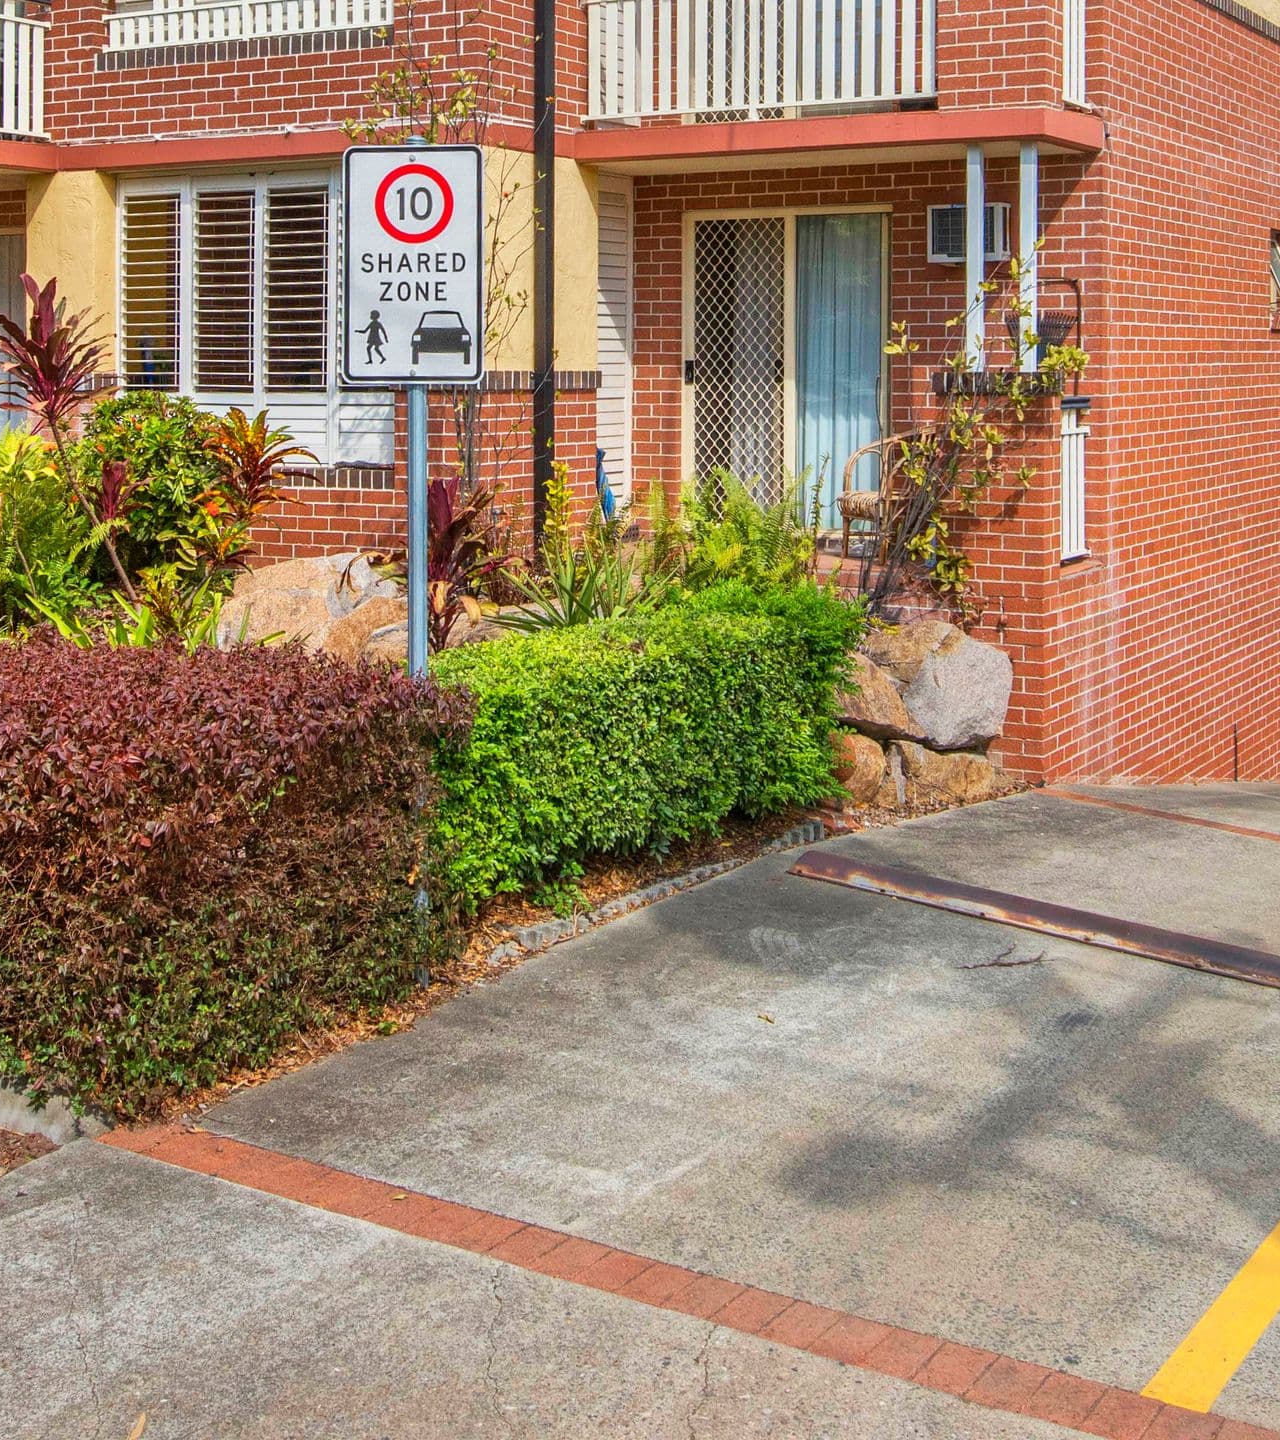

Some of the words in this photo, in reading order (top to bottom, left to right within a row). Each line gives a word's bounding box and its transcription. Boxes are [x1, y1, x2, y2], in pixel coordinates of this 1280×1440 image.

[396, 186, 433, 221] 10
[360, 252, 466, 274] SHARED
[379, 281, 448, 302] ZONE
